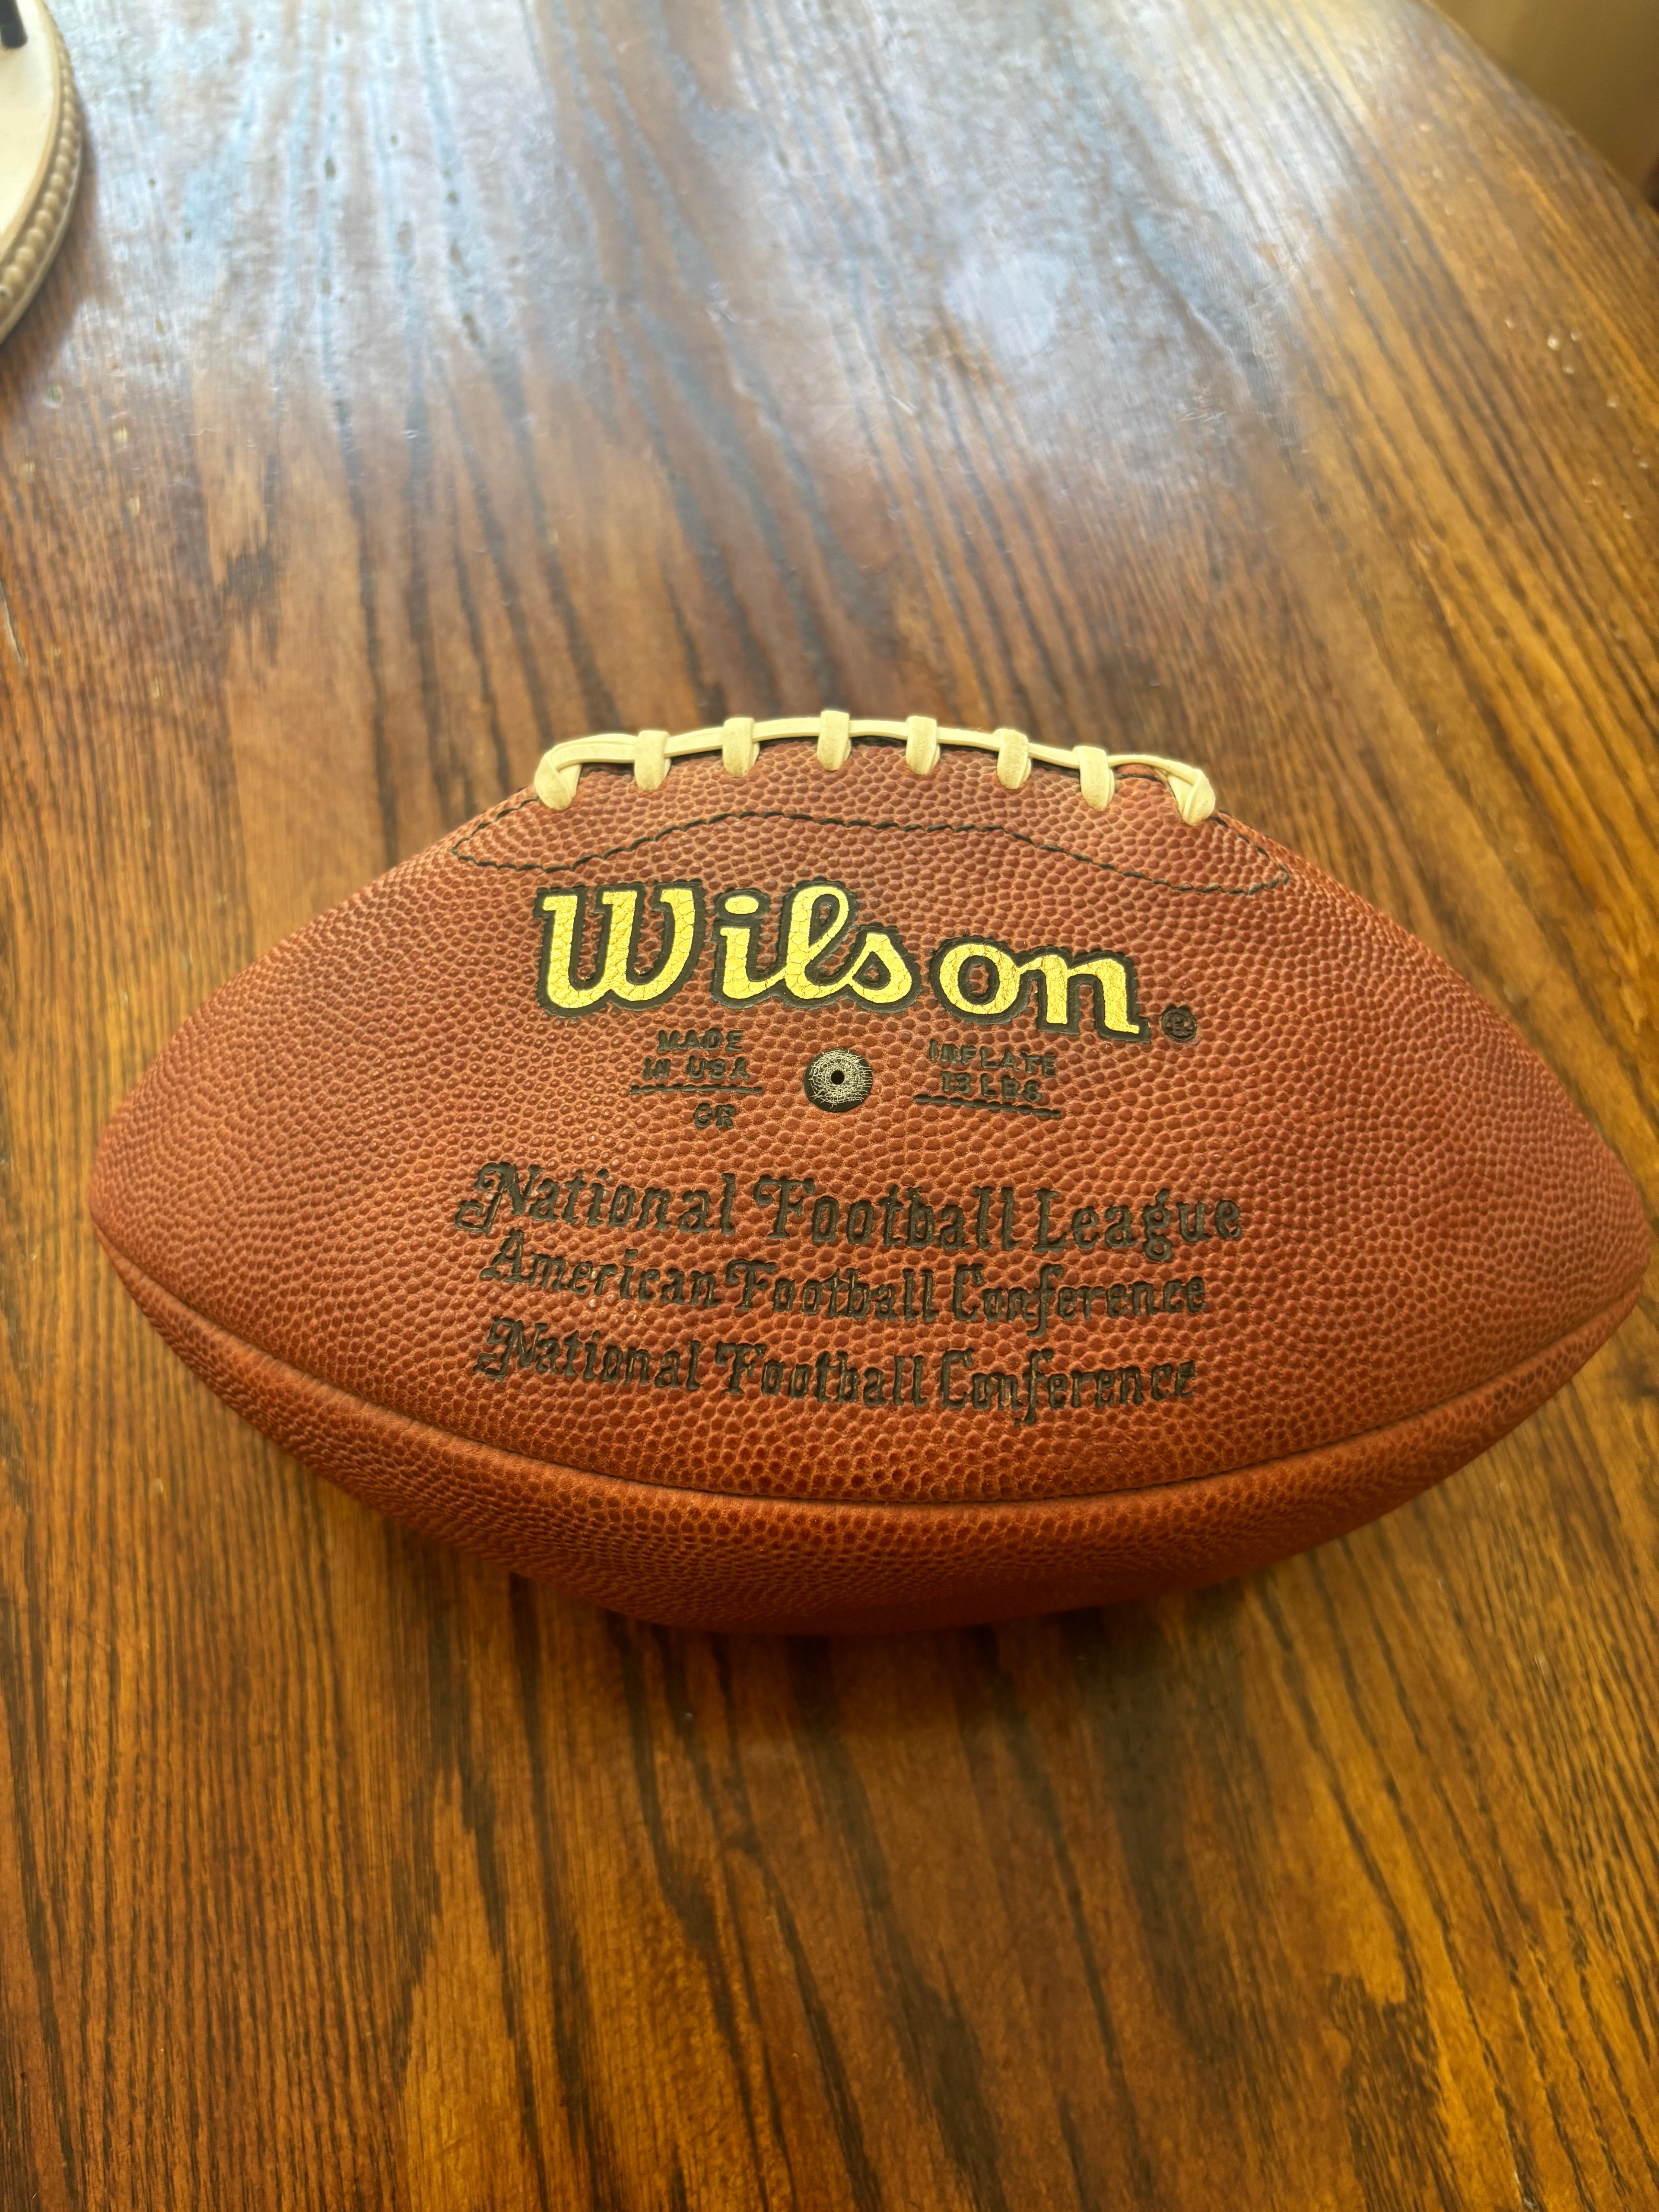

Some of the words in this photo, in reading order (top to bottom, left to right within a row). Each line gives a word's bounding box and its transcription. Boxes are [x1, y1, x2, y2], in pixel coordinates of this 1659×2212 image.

[537, 879, 1150, 1044] Wilson
[643, 1057, 671, 1080] IN
[686, 1055, 750, 1080] USA
[657, 1028, 743, 1052] MADE
[928, 1039, 1056, 1077] INFLATE
[941, 1071, 971, 1094] 13
[981, 1073, 1043, 1102] LBS
[454, 1162, 735, 1235] National
[753, 1173, 1020, 1251] Football
[1033, 1188, 1240, 1262] League
[480, 1228, 724, 1307] American
[725, 1259, 938, 1322] Football
[952, 1263, 1208, 1338] Conference
[474, 1317, 701, 1391] National
[715, 1341, 928, 1408] Football
[939, 1347, 1197, 1427] Conference
